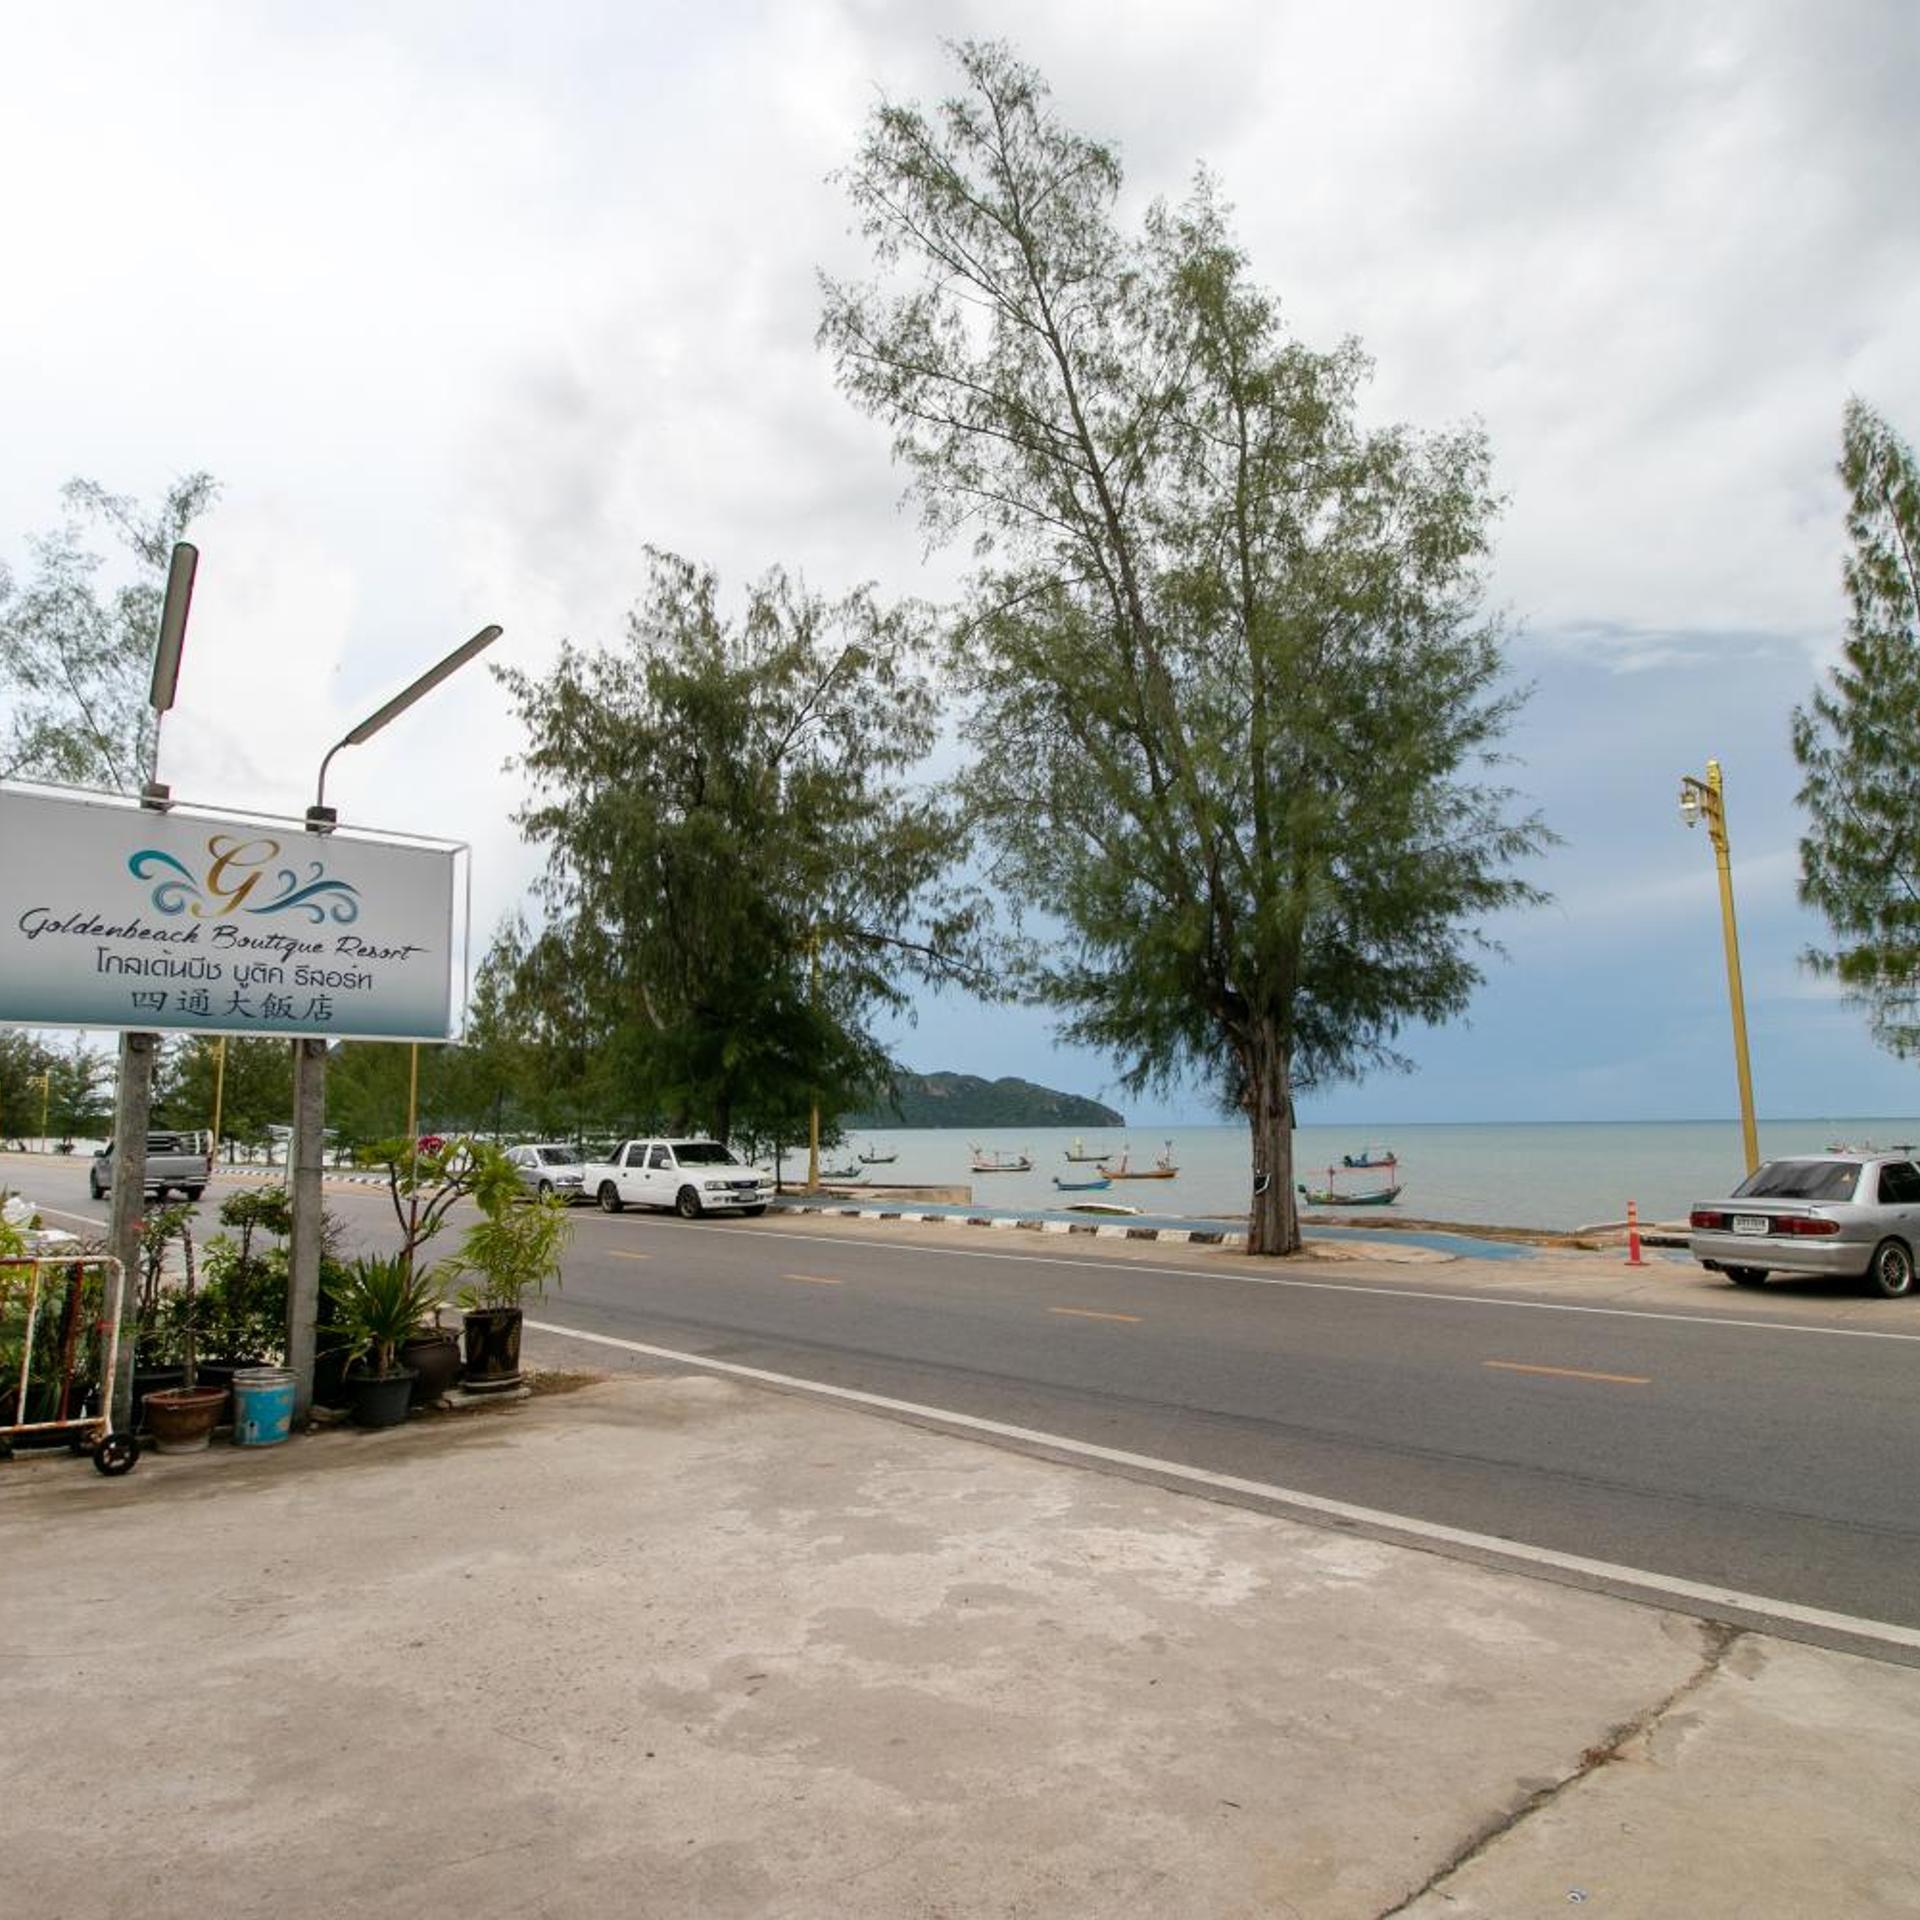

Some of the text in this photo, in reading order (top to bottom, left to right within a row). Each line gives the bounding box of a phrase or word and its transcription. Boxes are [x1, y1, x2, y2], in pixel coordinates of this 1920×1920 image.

[18, 907, 430, 963] Goldenbeach Boutique Resort
[131, 988, 334, 1023] 四通大飯店
